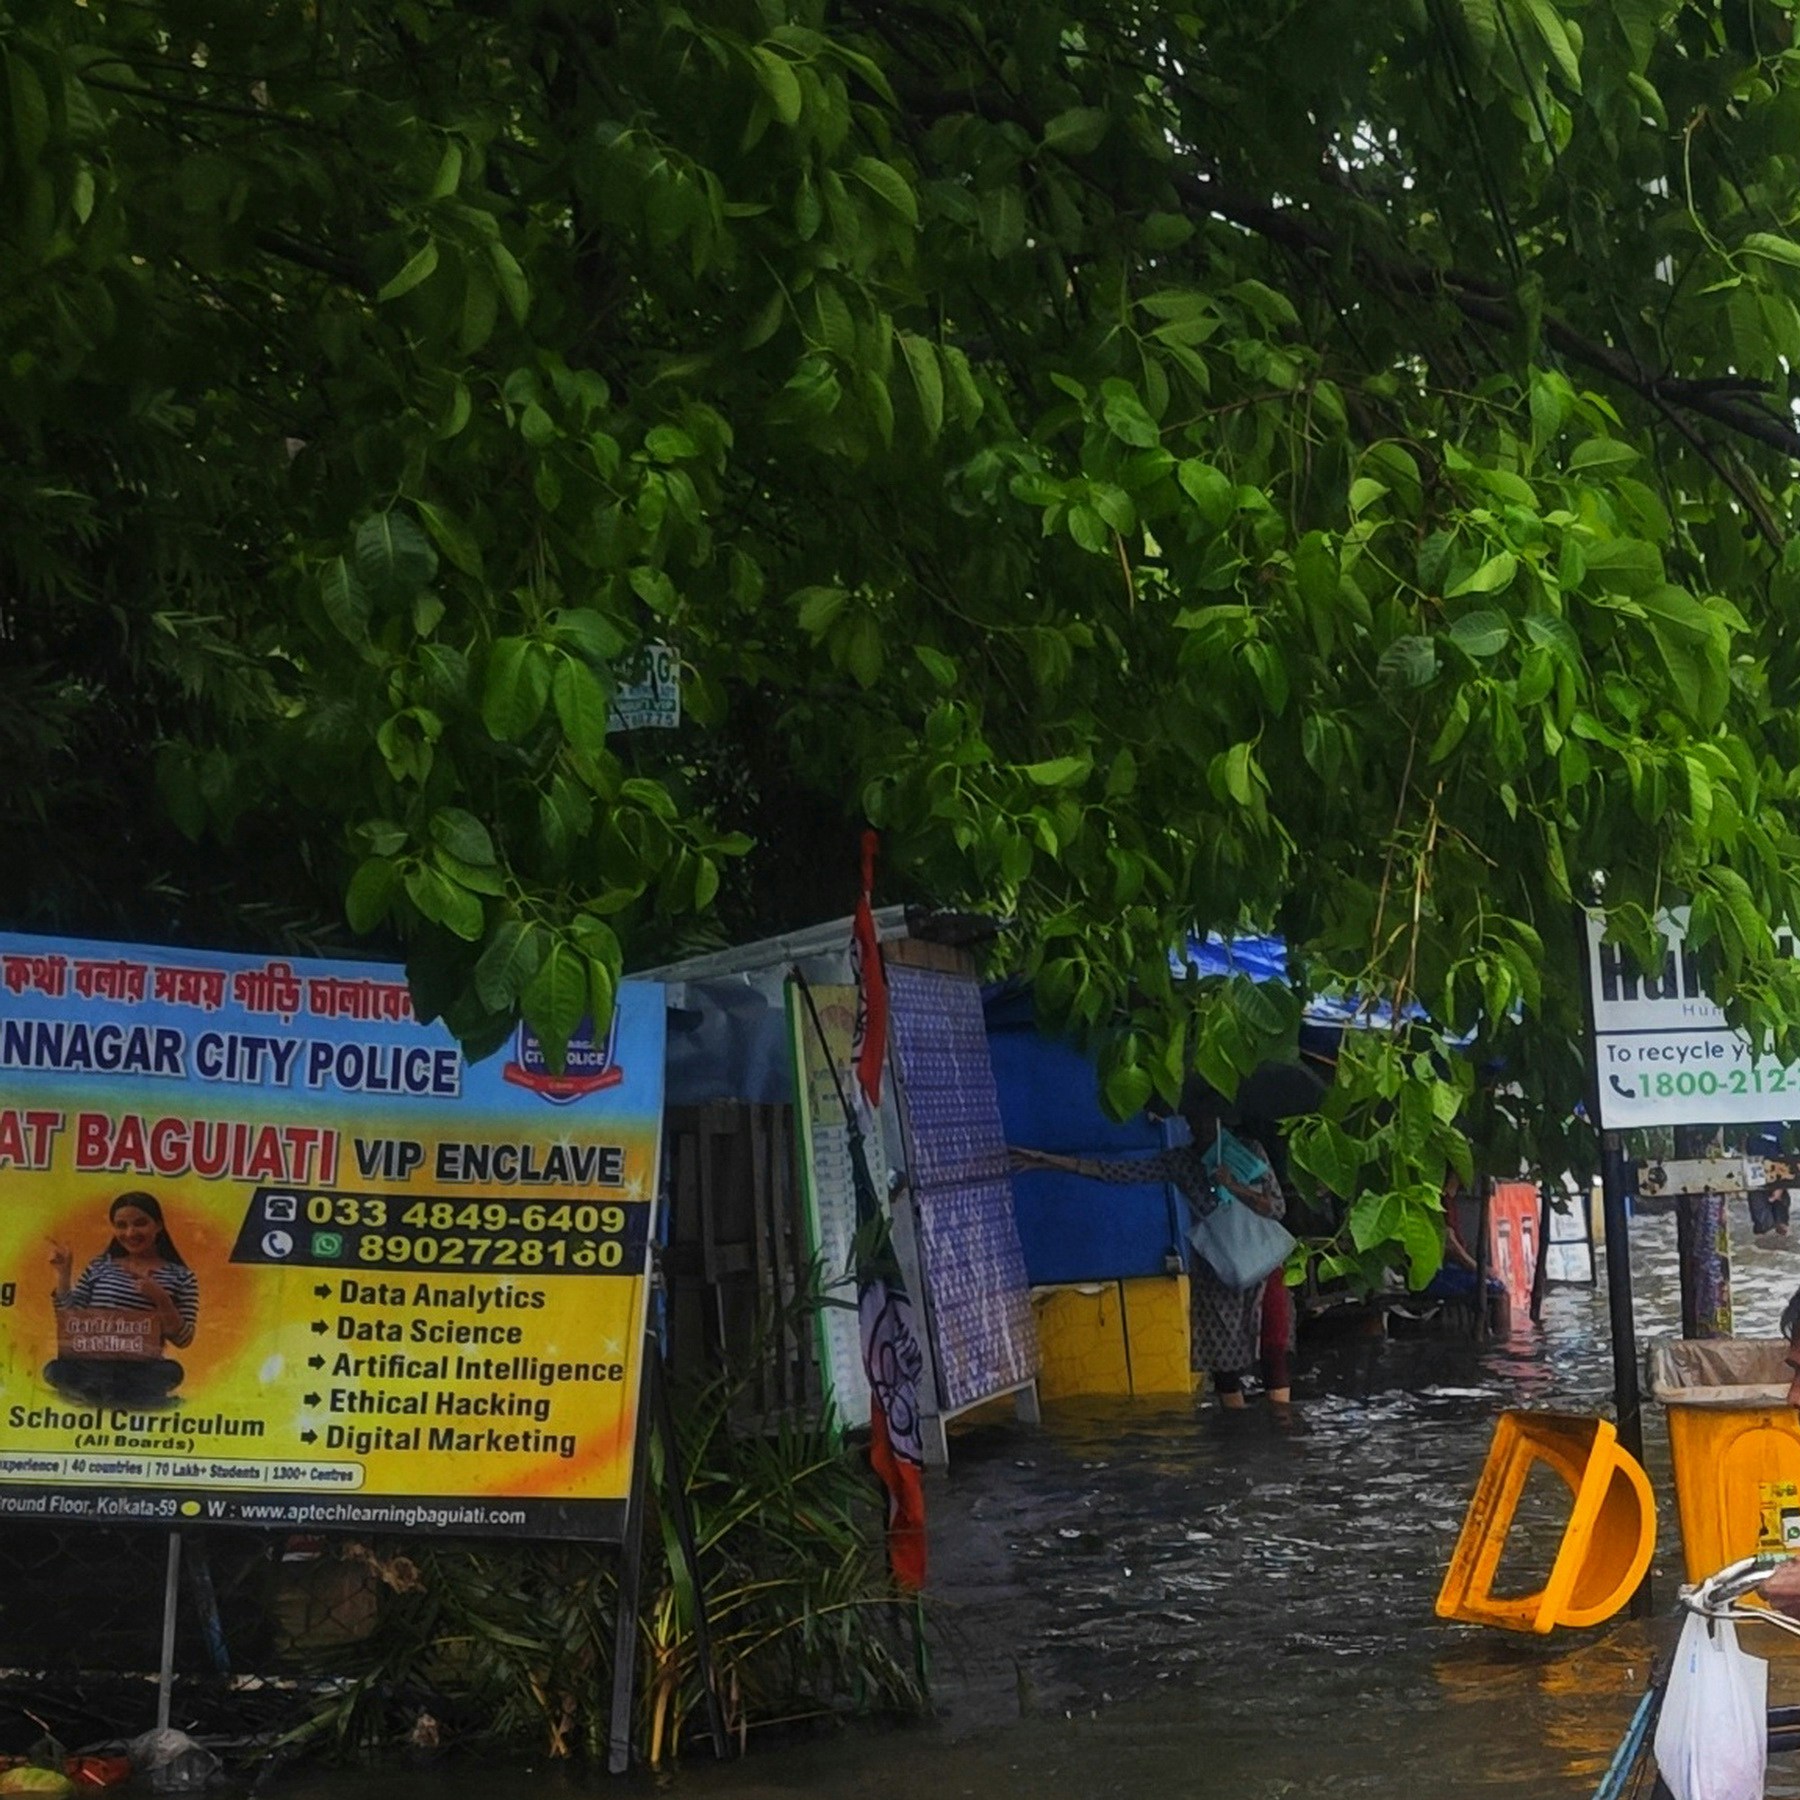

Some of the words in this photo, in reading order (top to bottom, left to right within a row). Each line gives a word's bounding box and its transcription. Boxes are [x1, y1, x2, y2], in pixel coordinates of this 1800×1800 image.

[2, 954, 68, 997] কথা
[74, 960, 146, 1004] বলার
[197, 1032, 298, 1086] CITY
[308, 1042, 460, 1095] POLICE
[566, 1053, 605, 1065] OLICE
[1607, 1043, 1631, 1063] To
[1638, 1041, 1724, 1064] recycle
[76, 1113, 339, 1184] BAGUIATI
[353, 1139, 423, 1178] VIP
[437, 1143, 624, 1185] ENCLAVE
[306, 1198, 388, 1226] 033
[401, 1202, 626, 1233] 4849-6409
[358, 1236, 623, 1267] 8902728160
[340, 1280, 406, 1306] Data
[412, 1284, 545, 1313] Analytics
[337, 1316, 403, 1342] Data
[411, 1319, 522, 1344] Science
[333, 1353, 447, 1379] Artifical
[457, 1357, 624, 1386] Intelligence
[330, 1388, 428, 1414] Ethical
[436, 1393, 550, 1421] Hacking
[9, 1406, 102, 1430] School
[111, 1410, 265, 1436] Curriculum
[75, 1434, 109, 1449] (All
[115, 1435, 195, 1452] Boards)
[327, 1425, 420, 1454] Digital
[428, 1428, 576, 1457] Marketing
[72, 1460, 85, 1472] 40
[89, 1461, 142, 1475] countries
[156, 1463, 170, 1475] 70
[210, 1465, 260, 1479] Students
[310, 1468, 353, 1482] Centres
[50, 1495, 93, 1515] Floor,
[97, 1497, 177, 1516] Kolkata-59
[208, 1500, 226, 1517] W
[241, 1503, 526, 1527] www.aptechlearningbaguiati.com
